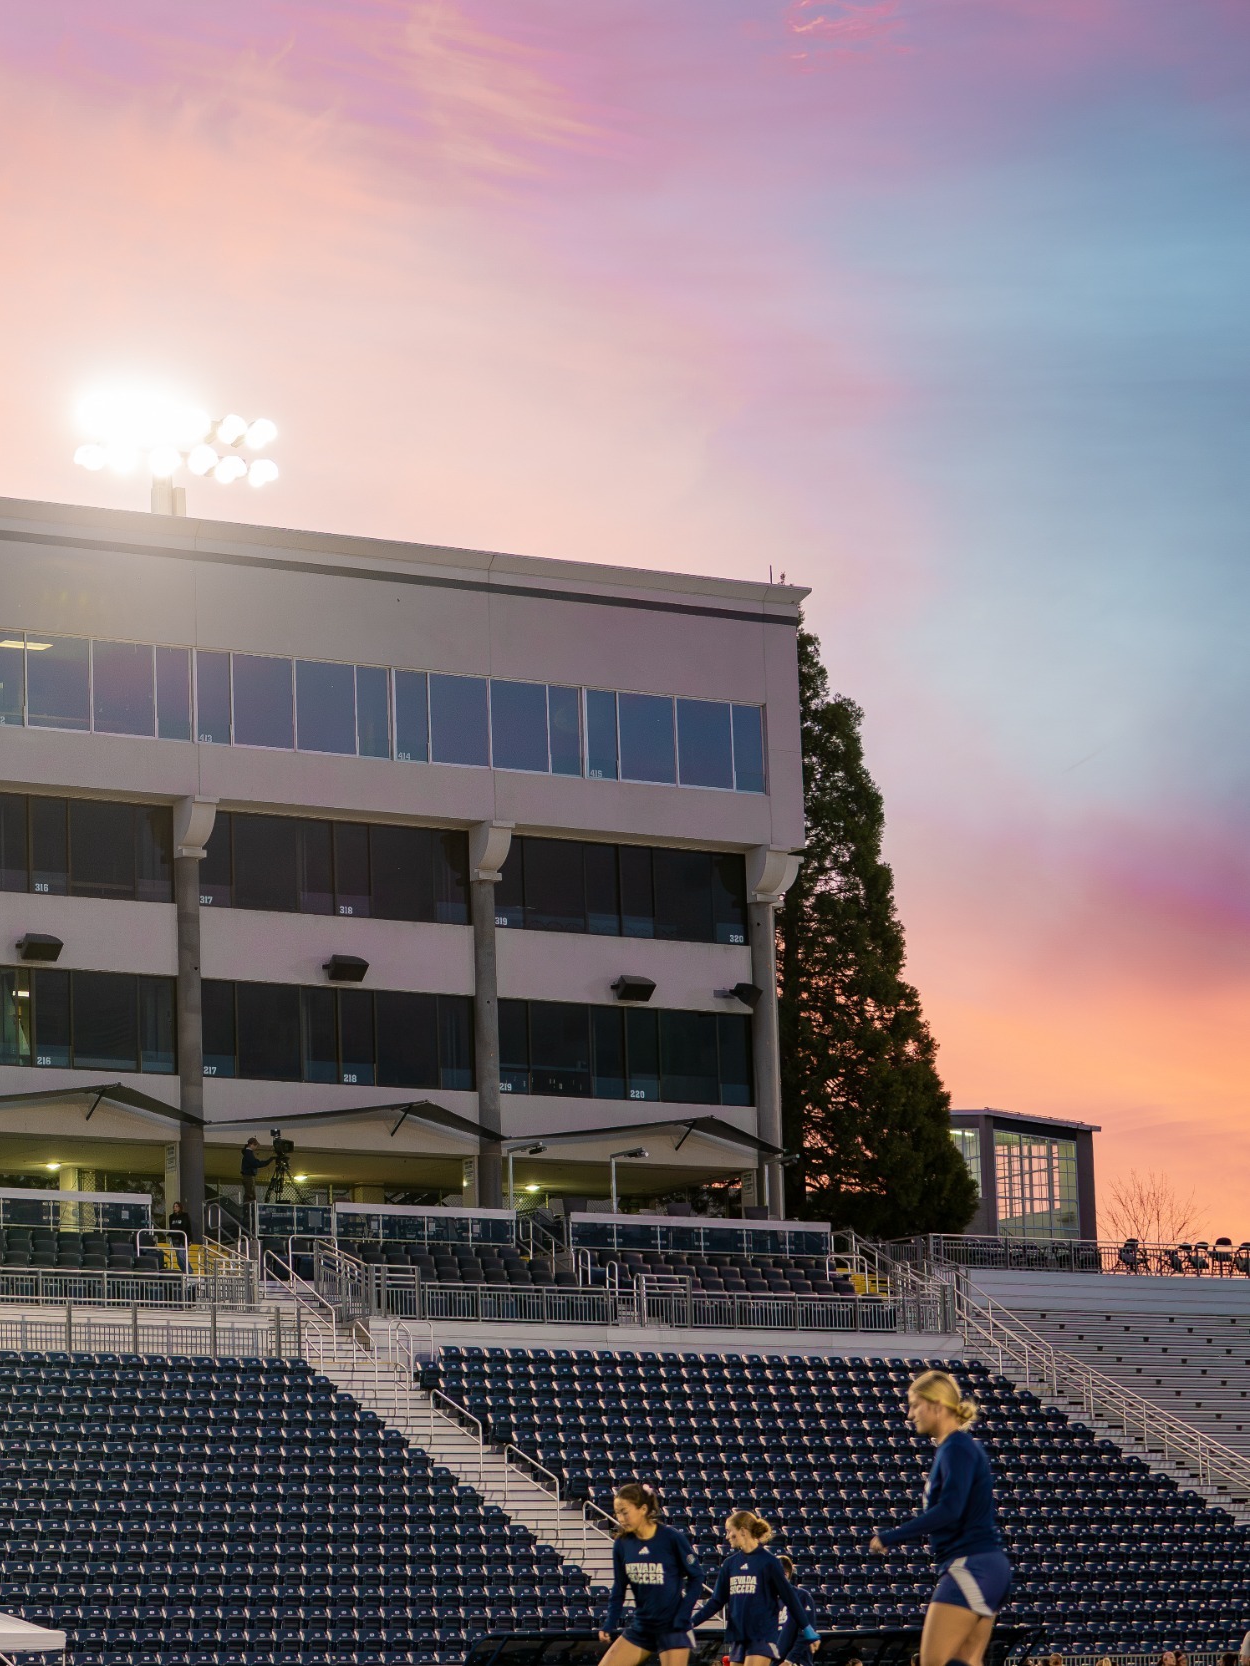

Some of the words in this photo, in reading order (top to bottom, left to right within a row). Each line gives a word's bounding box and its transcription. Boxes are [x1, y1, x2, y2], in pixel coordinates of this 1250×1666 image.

[397, 752, 411, 761] 414
[199, 895, 213, 904] 317
[339, 906, 353, 915] 318
[494, 917, 508, 926] 319
[729, 934, 744, 944] 320
[36, 1056, 51, 1065] 216
[203, 1066, 217, 1075] 217
[343, 1074, 357, 1083] 218
[499, 1083, 513, 1091] 219
[630, 1090, 645, 1099] 220
